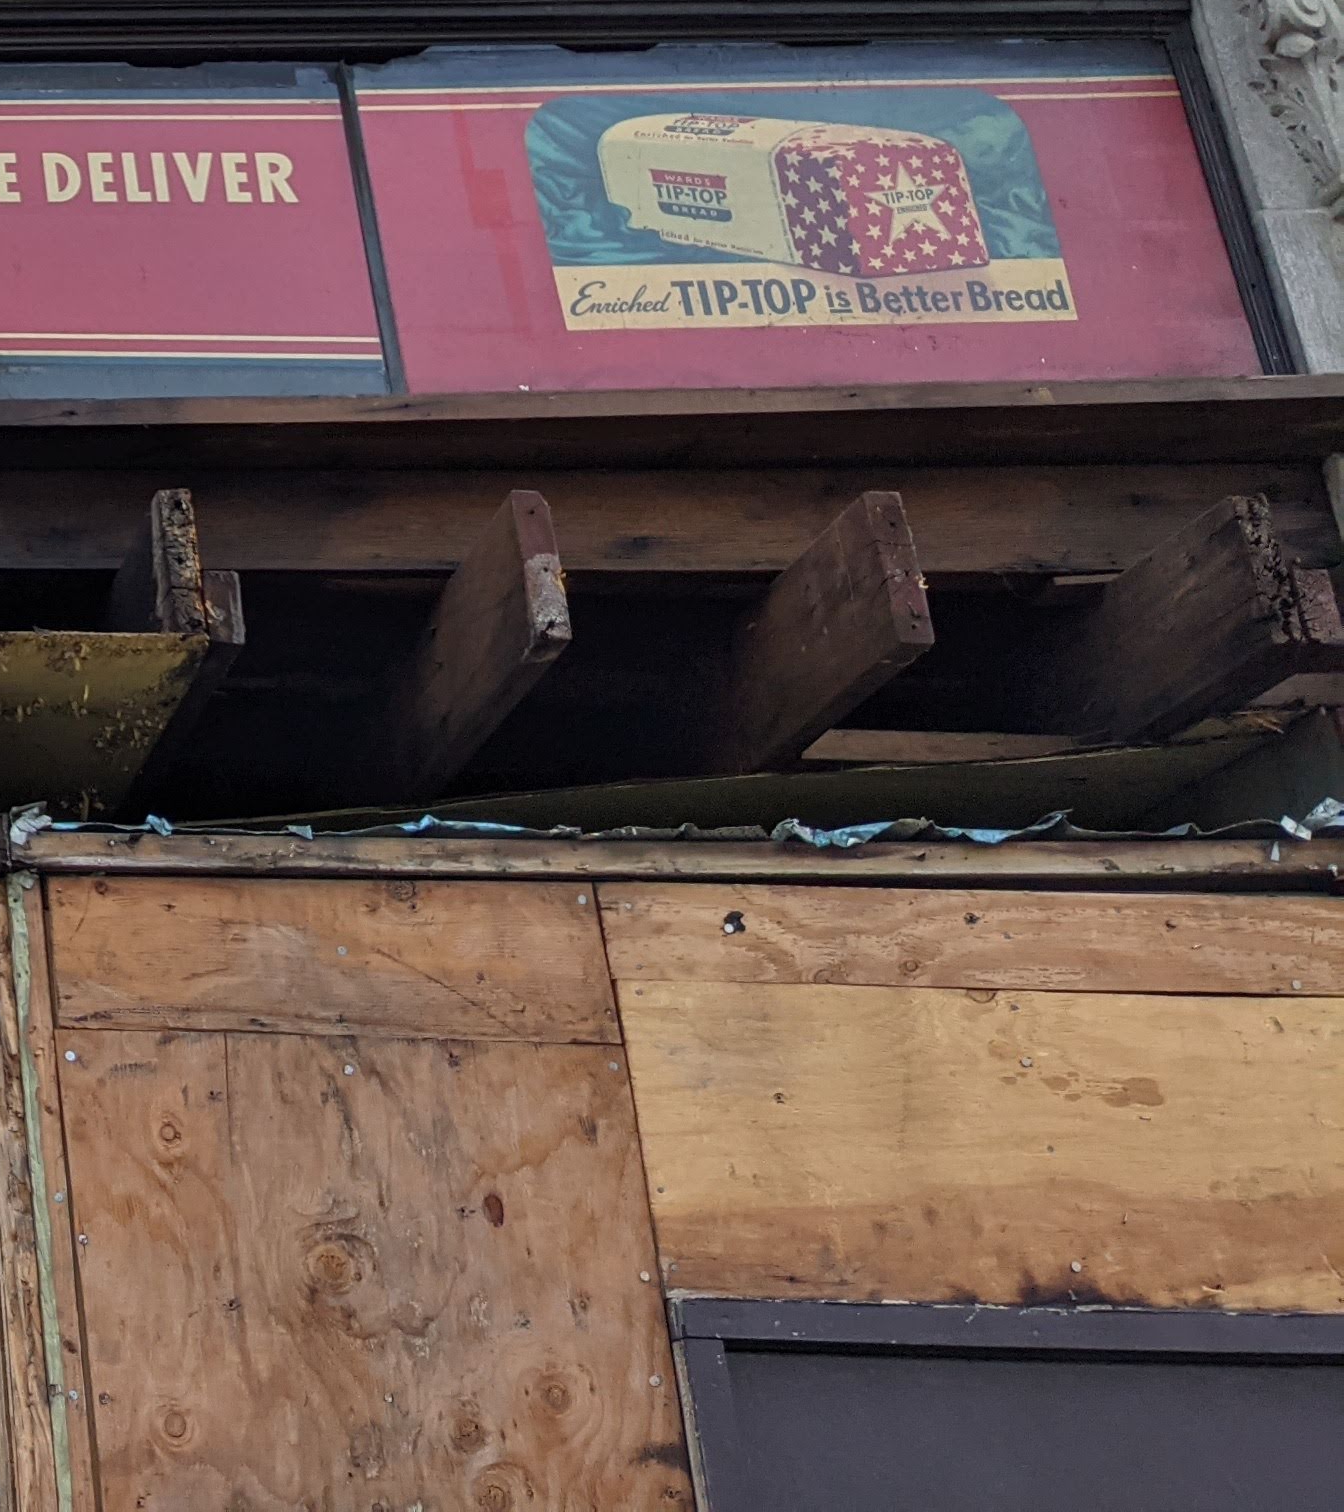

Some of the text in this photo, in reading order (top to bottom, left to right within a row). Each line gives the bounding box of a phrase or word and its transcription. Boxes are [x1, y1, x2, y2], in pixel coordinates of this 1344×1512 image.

[42, 152, 299, 204] DELIVER
[653, 183, 728, 206] TIP-TOP
[882, 188, 934, 205] TIP-TOP
[672, 204, 718, 218] BREAD
[570, 278, 1070, 317] Enriched TIP-TOP is Better Bread
